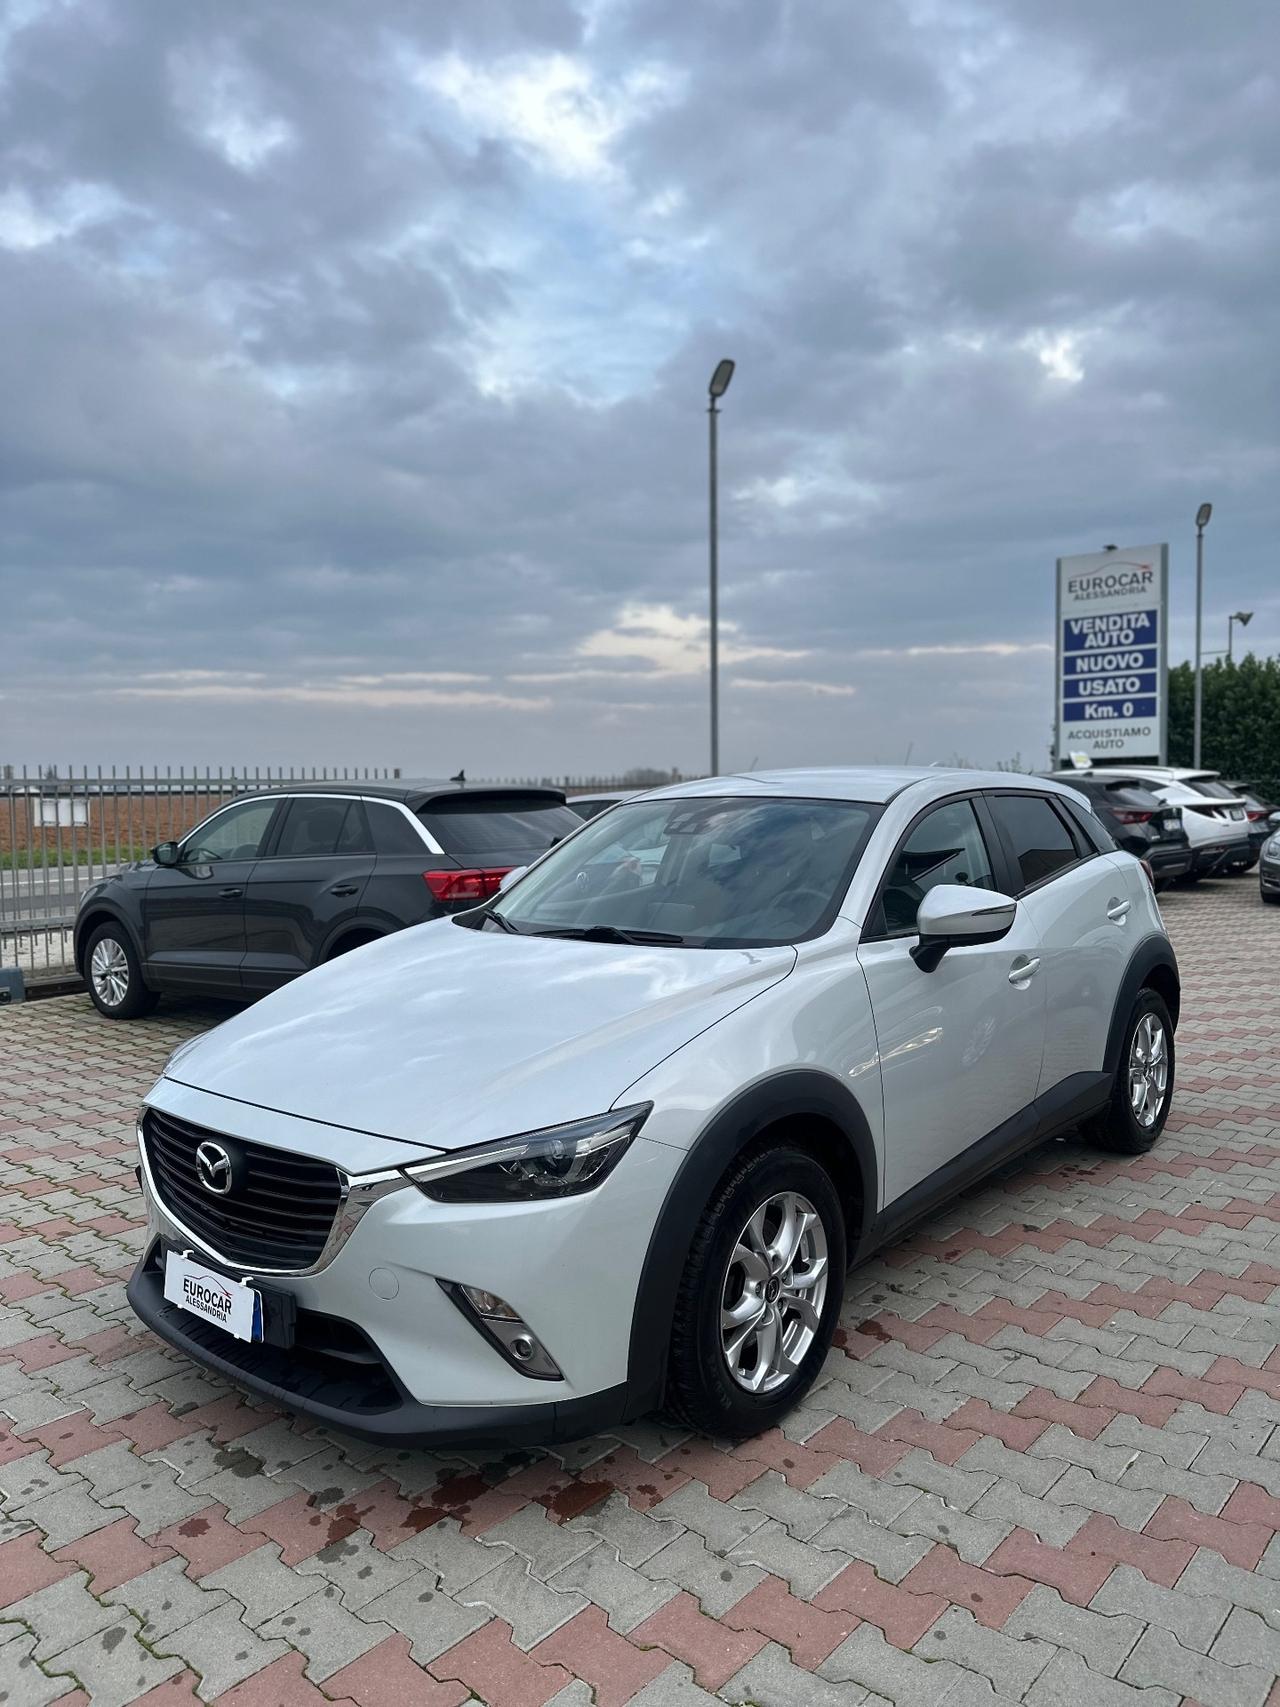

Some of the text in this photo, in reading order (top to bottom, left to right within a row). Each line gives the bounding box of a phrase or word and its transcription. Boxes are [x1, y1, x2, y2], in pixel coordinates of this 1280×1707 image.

[1068, 571, 1153, 593] EUROCAR
[1073, 585, 1147, 600] ALESSANDRIA
[1070, 613, 1150, 635] VENDITA
[1084, 629, 1135, 648] AUTO
[1076, 652, 1144, 673] NUOVO
[1078, 676, 1141, 696] USATO
[1084, 701, 1134, 719] Km. 0
[1068, 726, 1151, 740] ACQUISTIAMO
[1093, 739, 1124, 749] AUTO
[183, 1278, 232, 1315] EUROCAR
[185, 1295, 227, 1323] ALESSANDRIA
